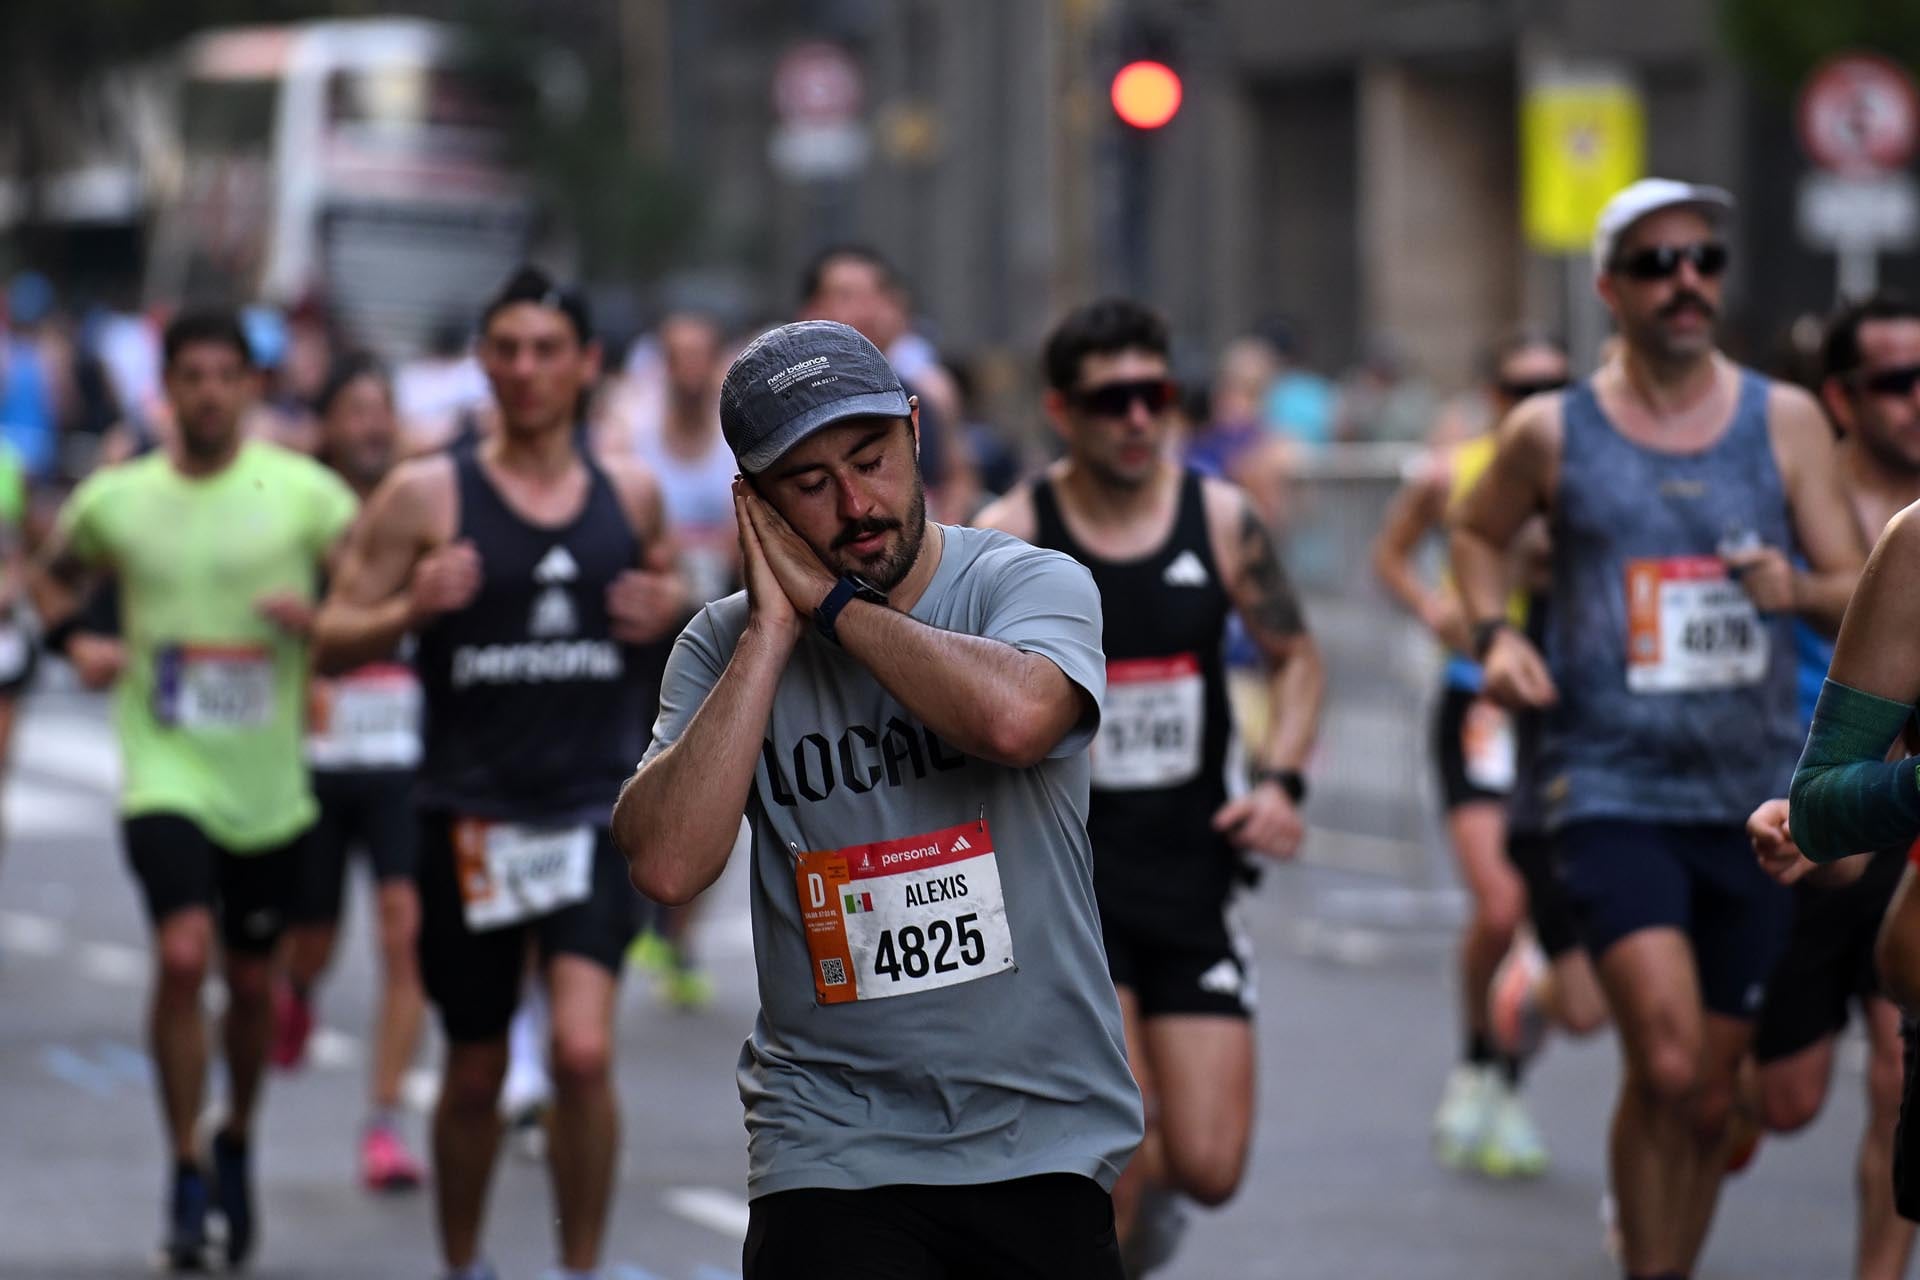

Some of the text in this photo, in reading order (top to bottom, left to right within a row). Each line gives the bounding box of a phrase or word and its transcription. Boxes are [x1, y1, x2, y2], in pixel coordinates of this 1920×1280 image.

[767, 356, 828, 385] new balance
[762, 715, 967, 808] LOCAL
[881, 842, 941, 868] personal
[807, 873, 826, 909] D
[905, 873, 969, 908] ALEXIS
[873, 912, 986, 982] 4825
